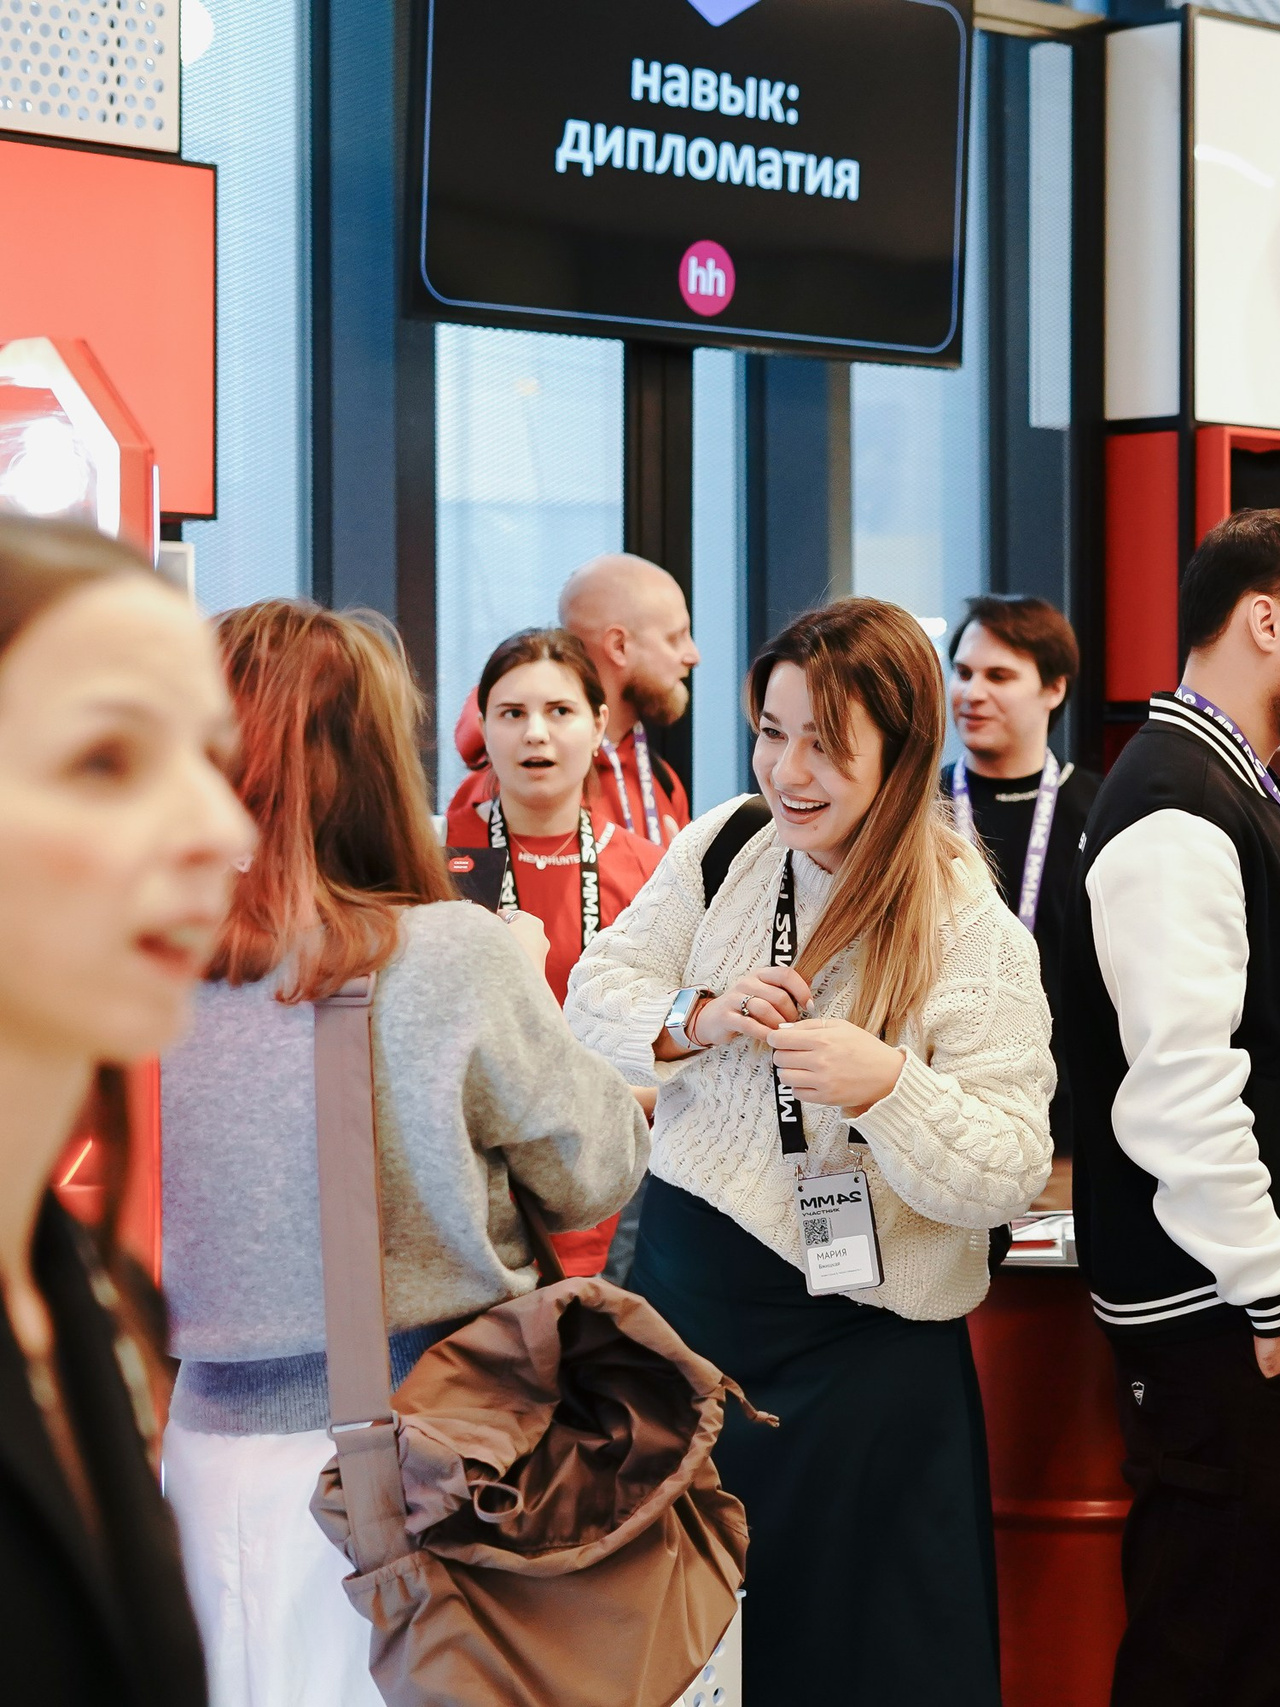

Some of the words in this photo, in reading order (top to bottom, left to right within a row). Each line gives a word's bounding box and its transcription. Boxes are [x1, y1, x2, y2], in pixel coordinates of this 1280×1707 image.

[631, 58, 799, 125] навык:
[555, 118, 861, 201] дипломатия
[688, 256, 727, 298] hh
[518, 851, 581, 866] HEADHUNTE
[802, 1207, 841, 1217] УЧАСТНИК
[816, 1248, 848, 1261] МАРИЯ
